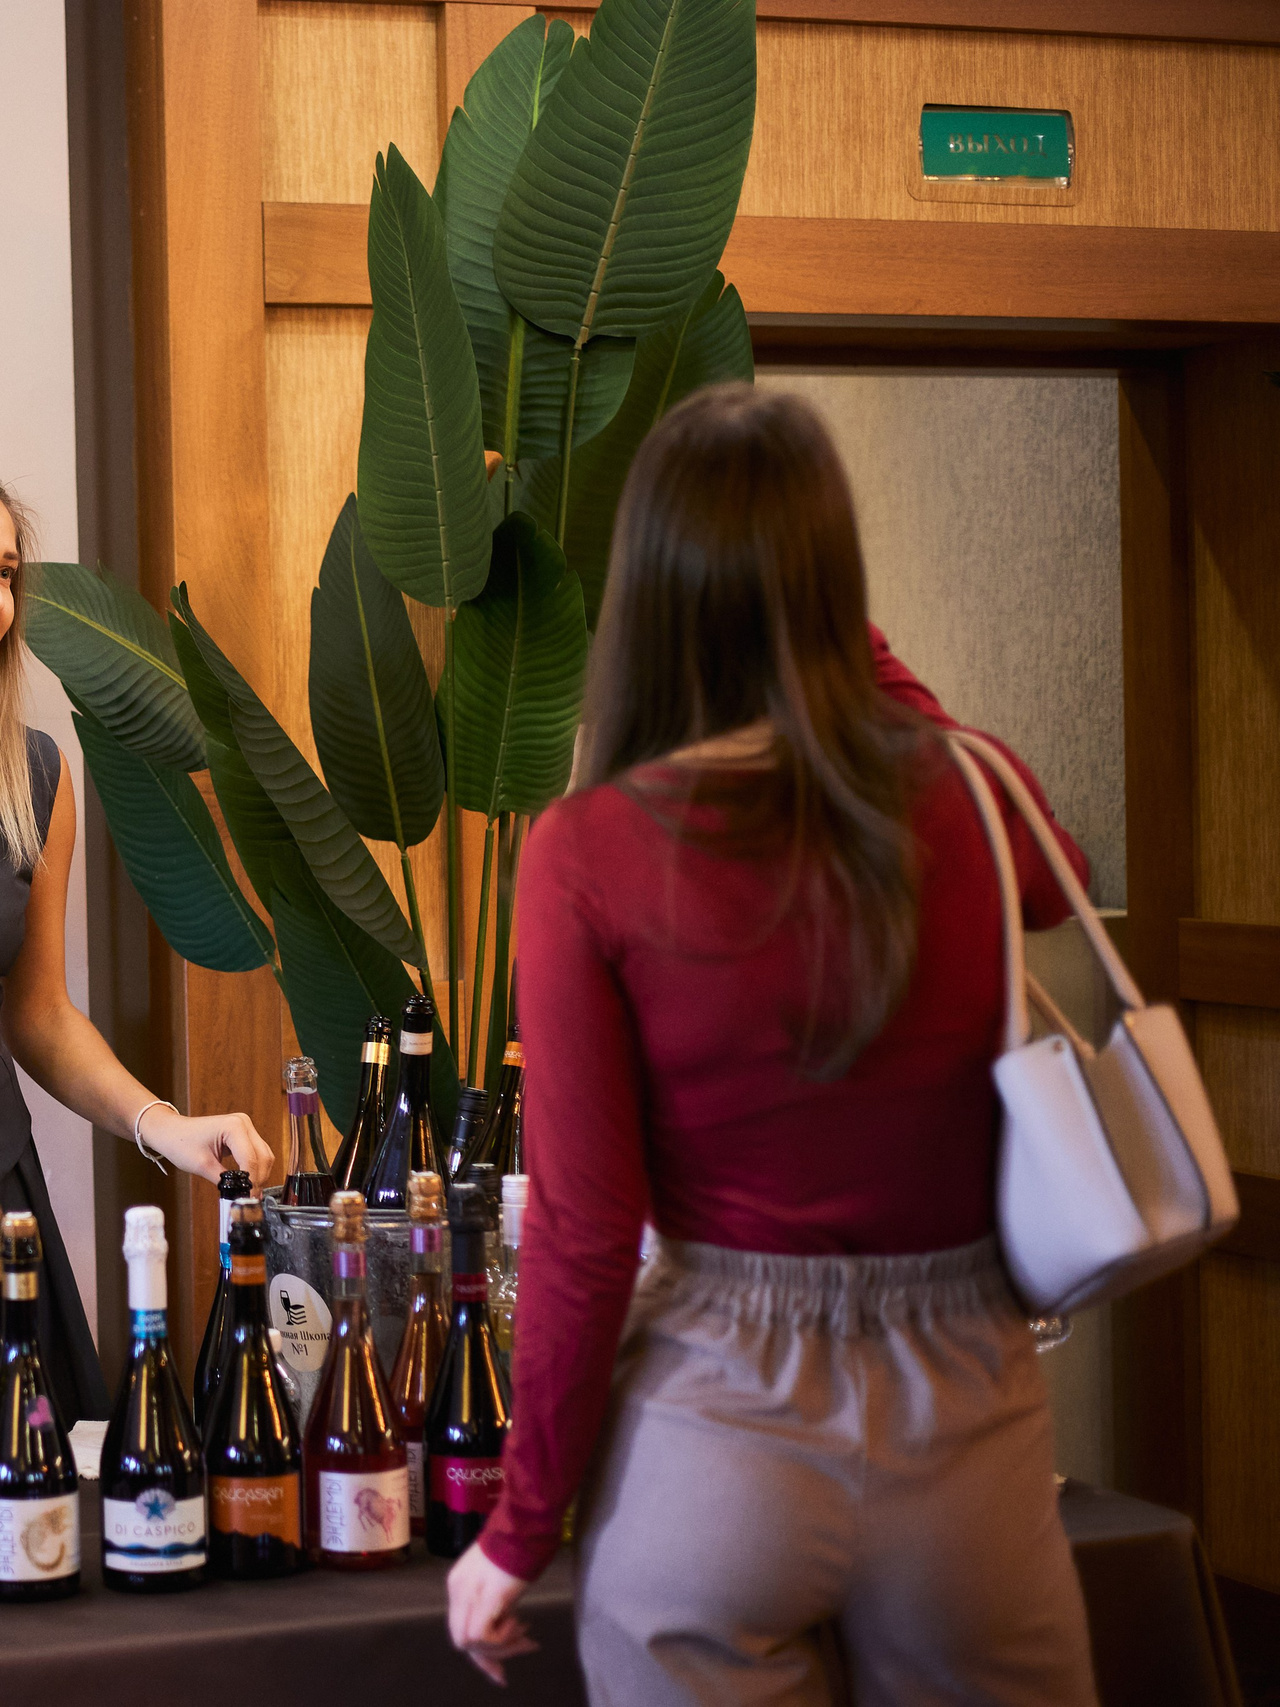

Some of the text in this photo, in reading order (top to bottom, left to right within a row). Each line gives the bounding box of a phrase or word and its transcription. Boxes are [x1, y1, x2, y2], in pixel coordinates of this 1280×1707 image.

[949, 133, 1048, 158] ВЫХОД
[300, 1330, 332, 1341] Школа
[133, 1521, 195, 1537] CASPICO
